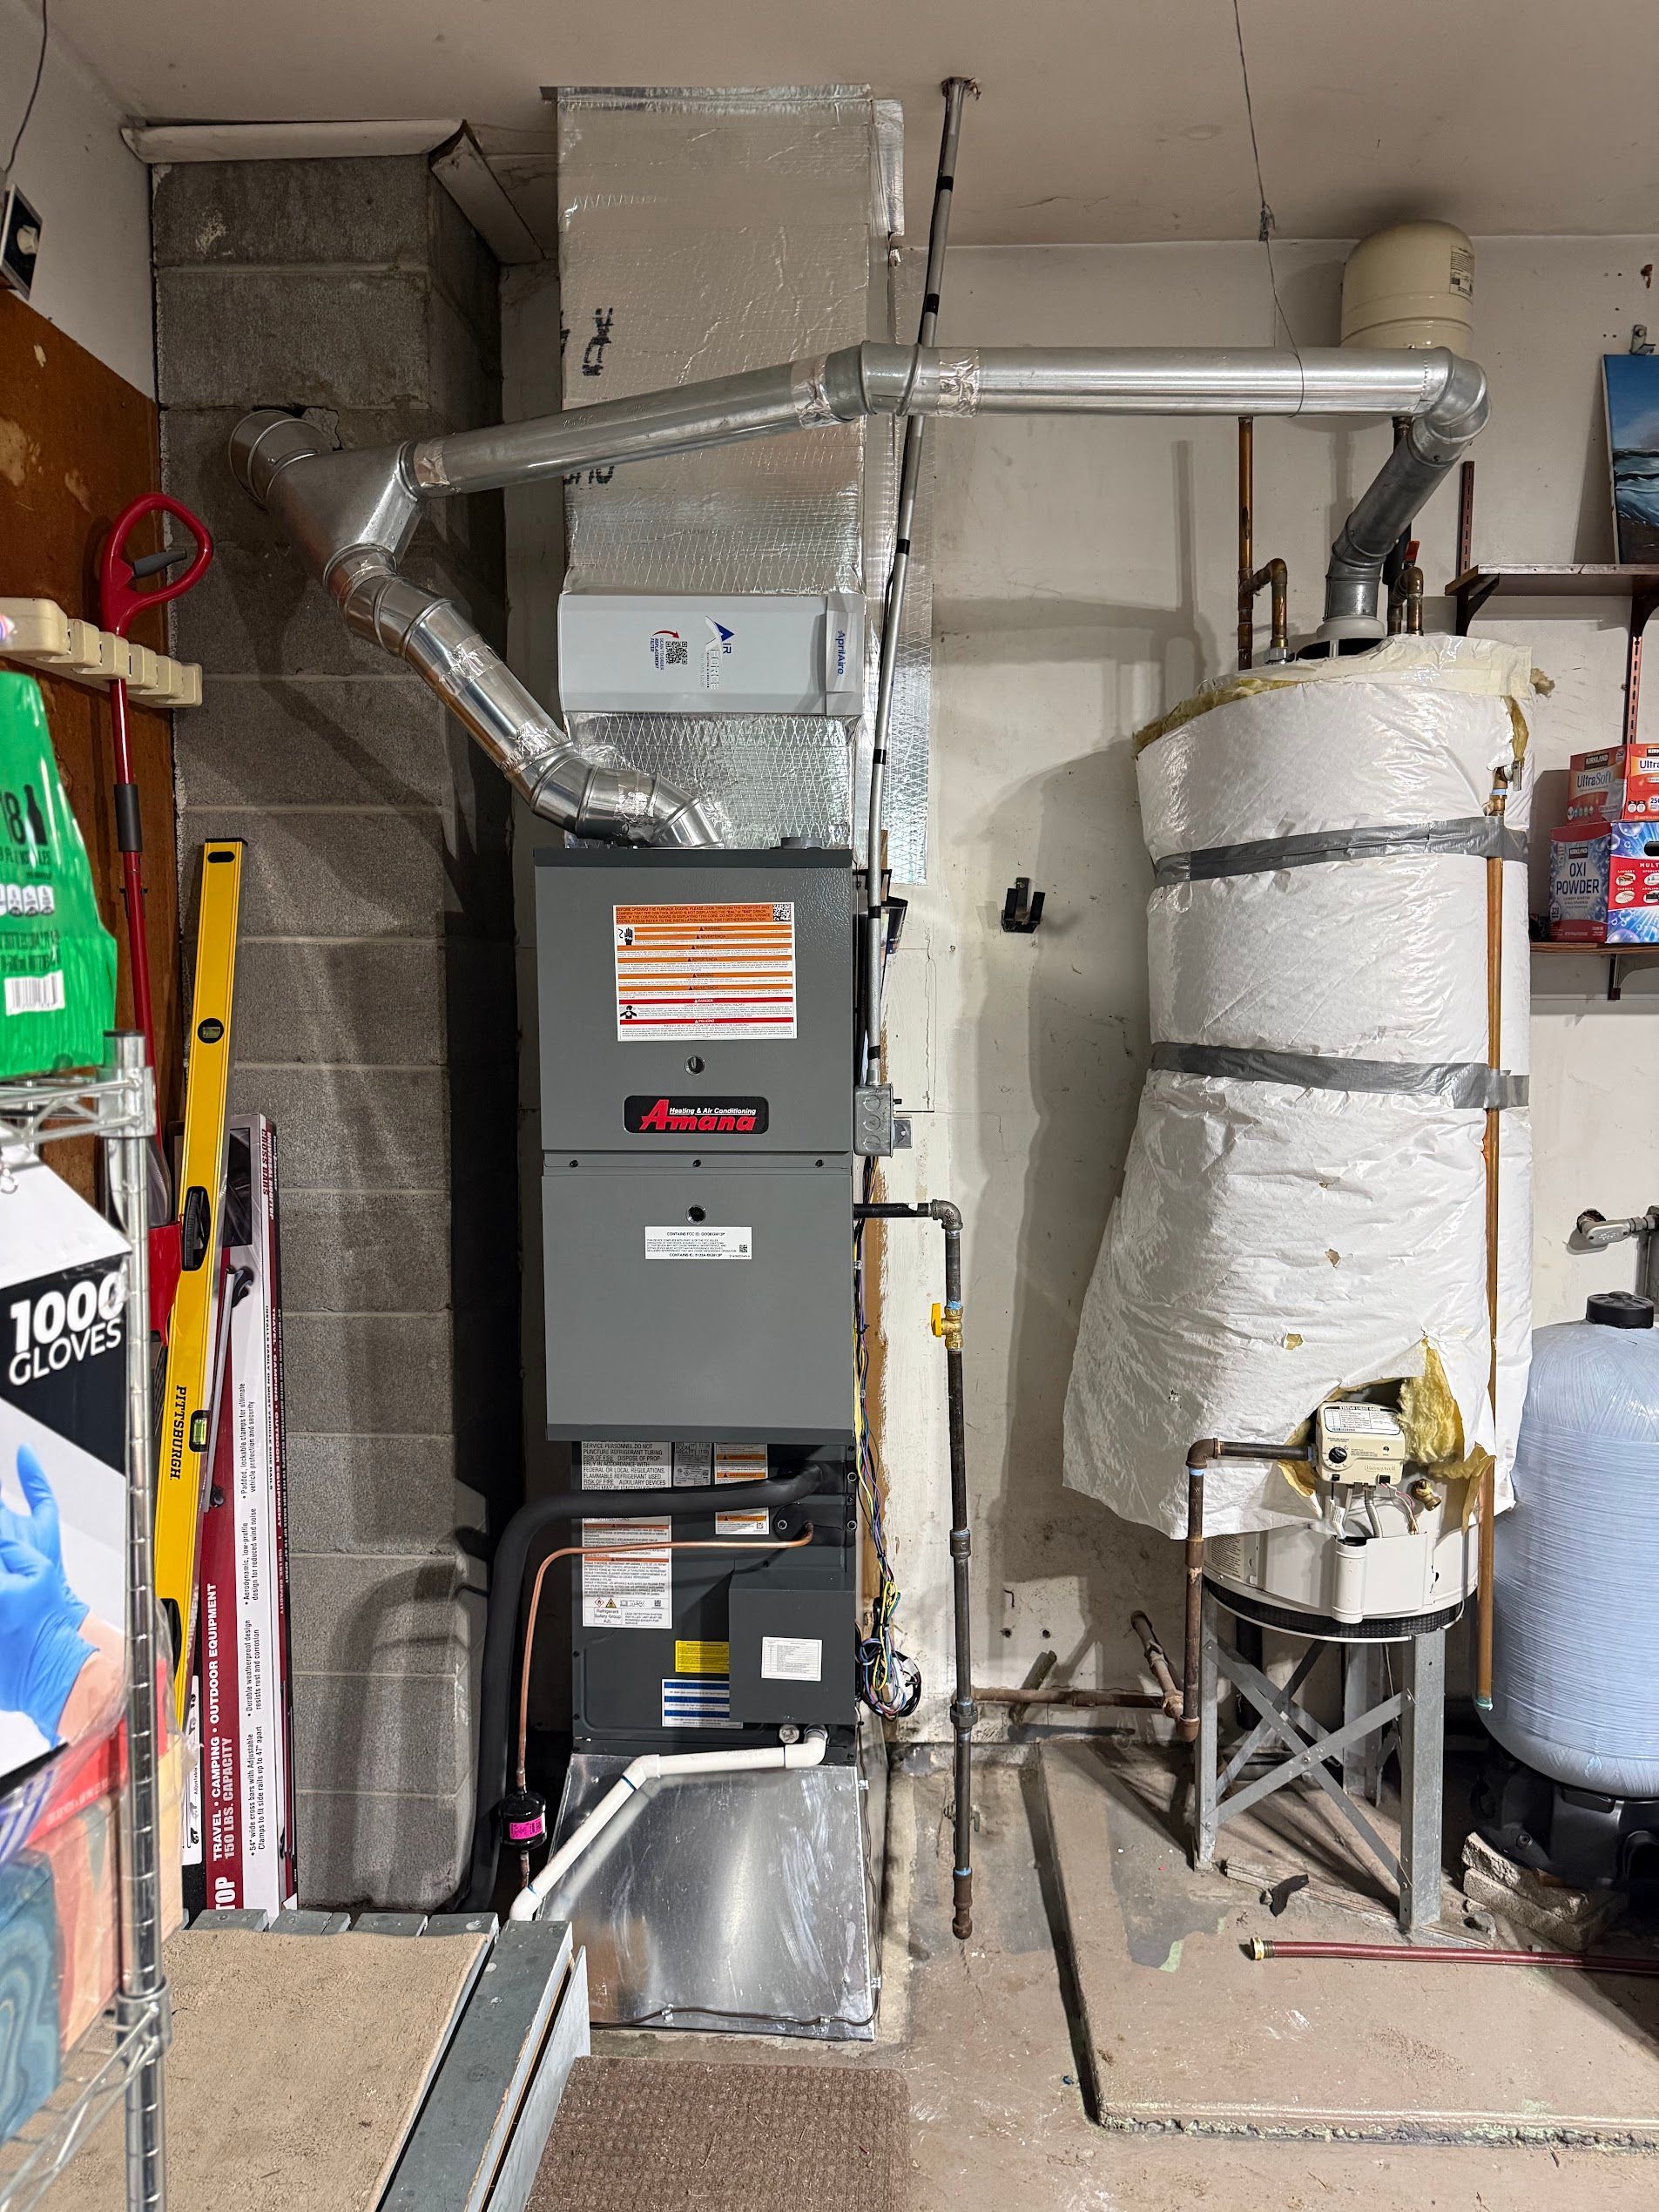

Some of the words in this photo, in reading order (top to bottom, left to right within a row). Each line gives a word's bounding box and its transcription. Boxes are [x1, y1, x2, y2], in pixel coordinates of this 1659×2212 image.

[836, 630, 846, 675] AprilAire
[1586, 754, 1608, 765] KIRKLAND
[1577, 771, 1612, 788] UltraSoft
[1569, 862, 1586, 877] OXI
[1556, 879, 1599, 894] POWDER
[639, 1099, 757, 1130] Amana
[670, 1107, 695, 1116] Heating
[10, 1271, 125, 1353] 1000
[9, 1318, 121, 1386] GLOVES
[246, 1401, 255, 1425] security
[170, 1386, 186, 1480] PITTSBURGH
[247, 1438, 256, 1469] protection
[242, 1557, 251, 1600] Aerodynamic,
[207, 1583, 218, 1657] EQUIPMENT
[209, 1660, 219, 1724] OUTDOOR
[211, 1737, 221, 1798] CAMPING
[246, 1734, 255, 1769] Adjustable
[222, 1737, 233, 1801] CAPACITY
[256, 1765, 265, 1774] up
[223, 1803, 234, 1831] LBS.
[212, 1810, 222, 1862] TRAVEL
[223, 1834, 234, 1859] 150
